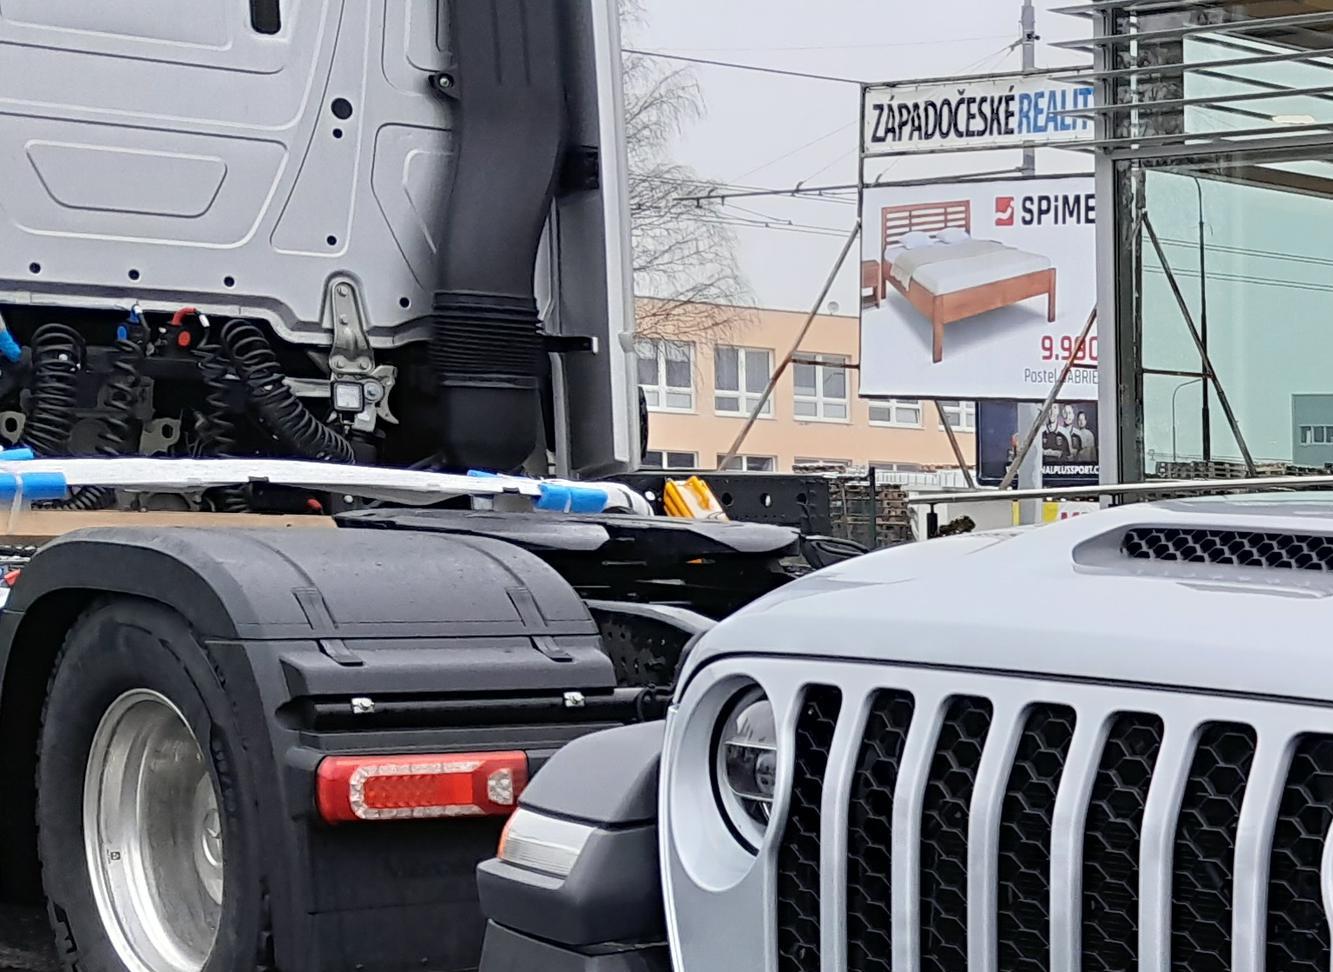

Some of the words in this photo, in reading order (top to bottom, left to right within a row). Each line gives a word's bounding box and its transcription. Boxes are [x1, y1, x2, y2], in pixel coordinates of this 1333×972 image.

[871, 85, 1015, 143] ZÁPADOČESKÉ
[1024, 367, 1057, 384] Postel
[1060, 368, 1098, 385] ABRIE
